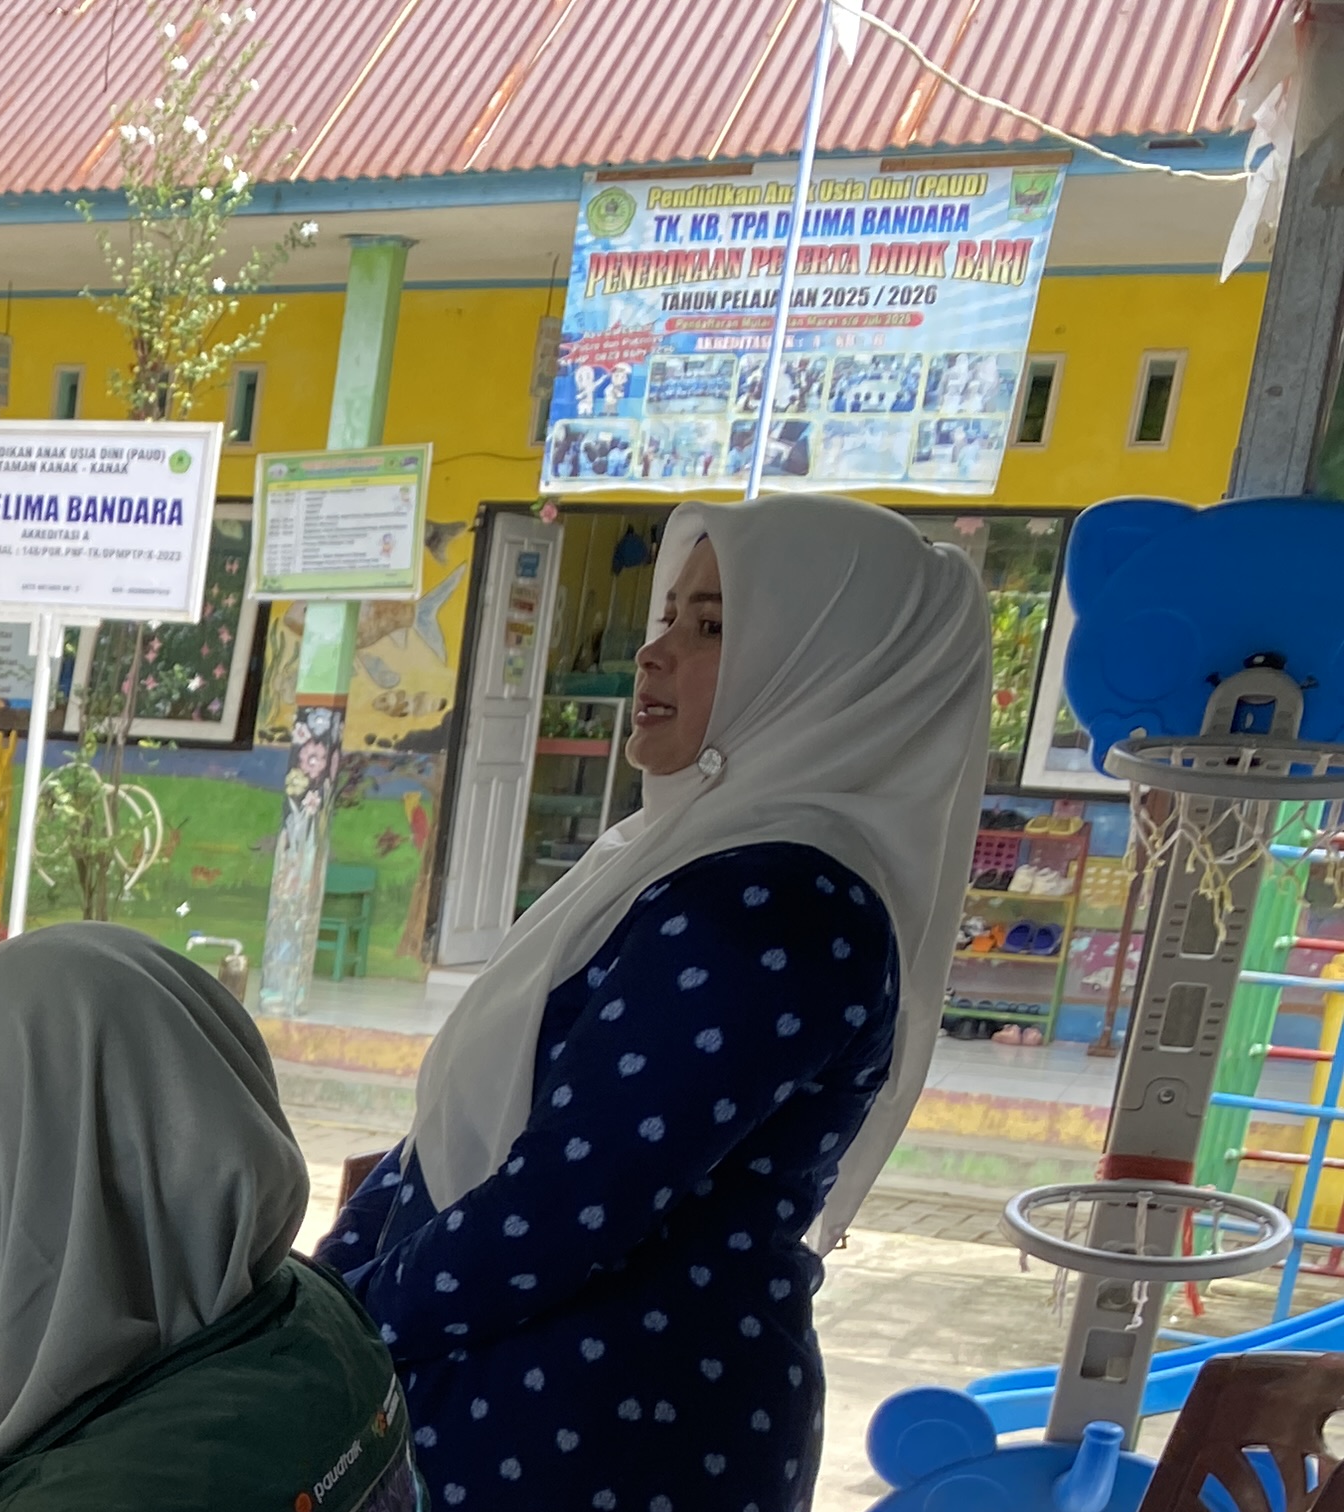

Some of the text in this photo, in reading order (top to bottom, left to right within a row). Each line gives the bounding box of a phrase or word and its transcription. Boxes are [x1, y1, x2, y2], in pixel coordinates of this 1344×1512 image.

[647, 184, 762, 210] Pendidikan
[819, 178, 865, 202] Usia
[869, 175, 912, 200] Dini
[915, 173, 989, 198] (PAUD)
[653, 203, 971, 244] TK, KB, TPA DLIMA BANDARA
[584, 237, 1034, 298] PENERIMAAN PEERTA DIDIK BARU
[661, 284, 938, 311] TAHUN PELAJAAN 2025 / 2026
[36, 446, 66, 459] ANAK
[70, 446, 96, 460] USIA
[100, 447, 123, 460] DINI
[126, 448, 166, 463] (PAUD)
[40, 460, 78, 474] KANAK
[89, 461, 129, 475] KANAK
[66, 495, 183, 526] BANDARA
[21, 528, 90, 541] AKREDITASI A
